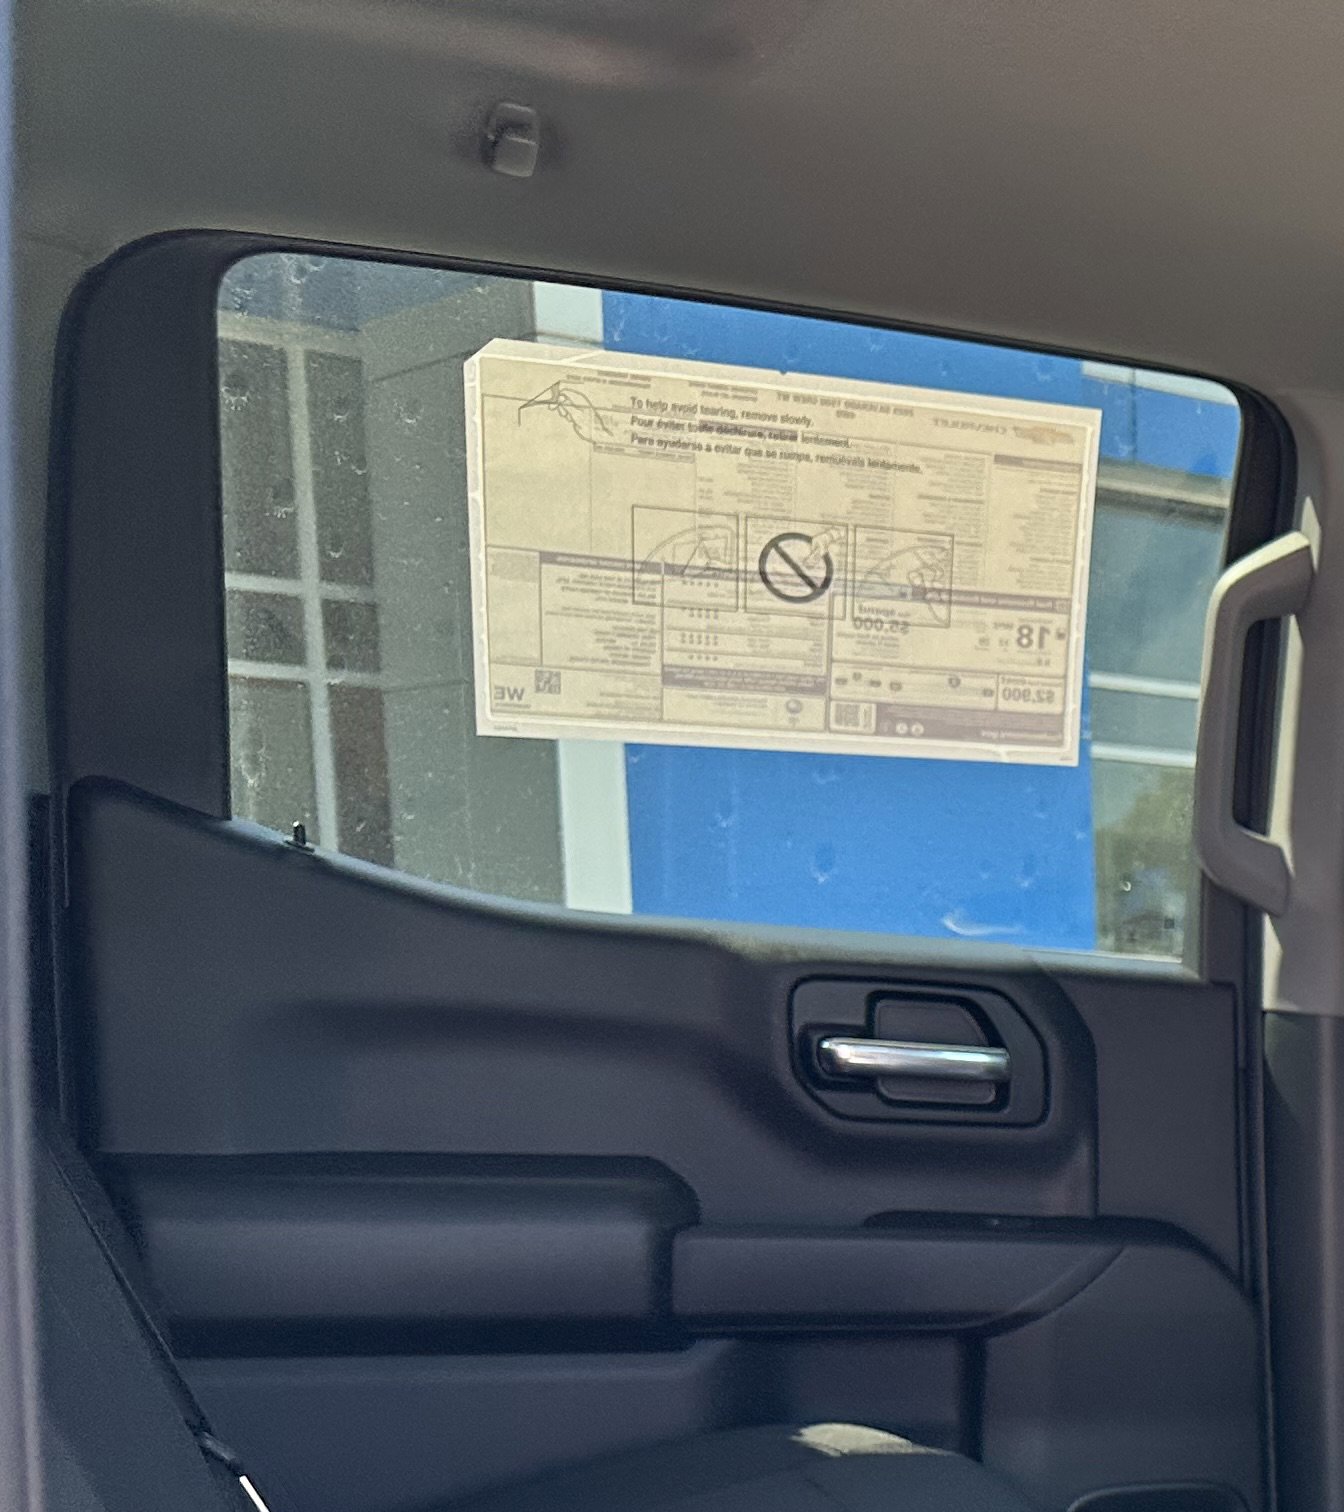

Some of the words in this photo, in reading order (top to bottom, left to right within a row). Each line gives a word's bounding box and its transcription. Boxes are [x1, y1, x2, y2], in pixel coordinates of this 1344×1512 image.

[630, 396, 643, 409] To
[646, 398, 668, 413] help
[671, 402, 698, 415] avoid
[700, 405, 738, 420] tearing,
[741, 409, 778, 423] remove
[630, 415, 654, 428] Pour
[630, 431, 654, 446] Para
